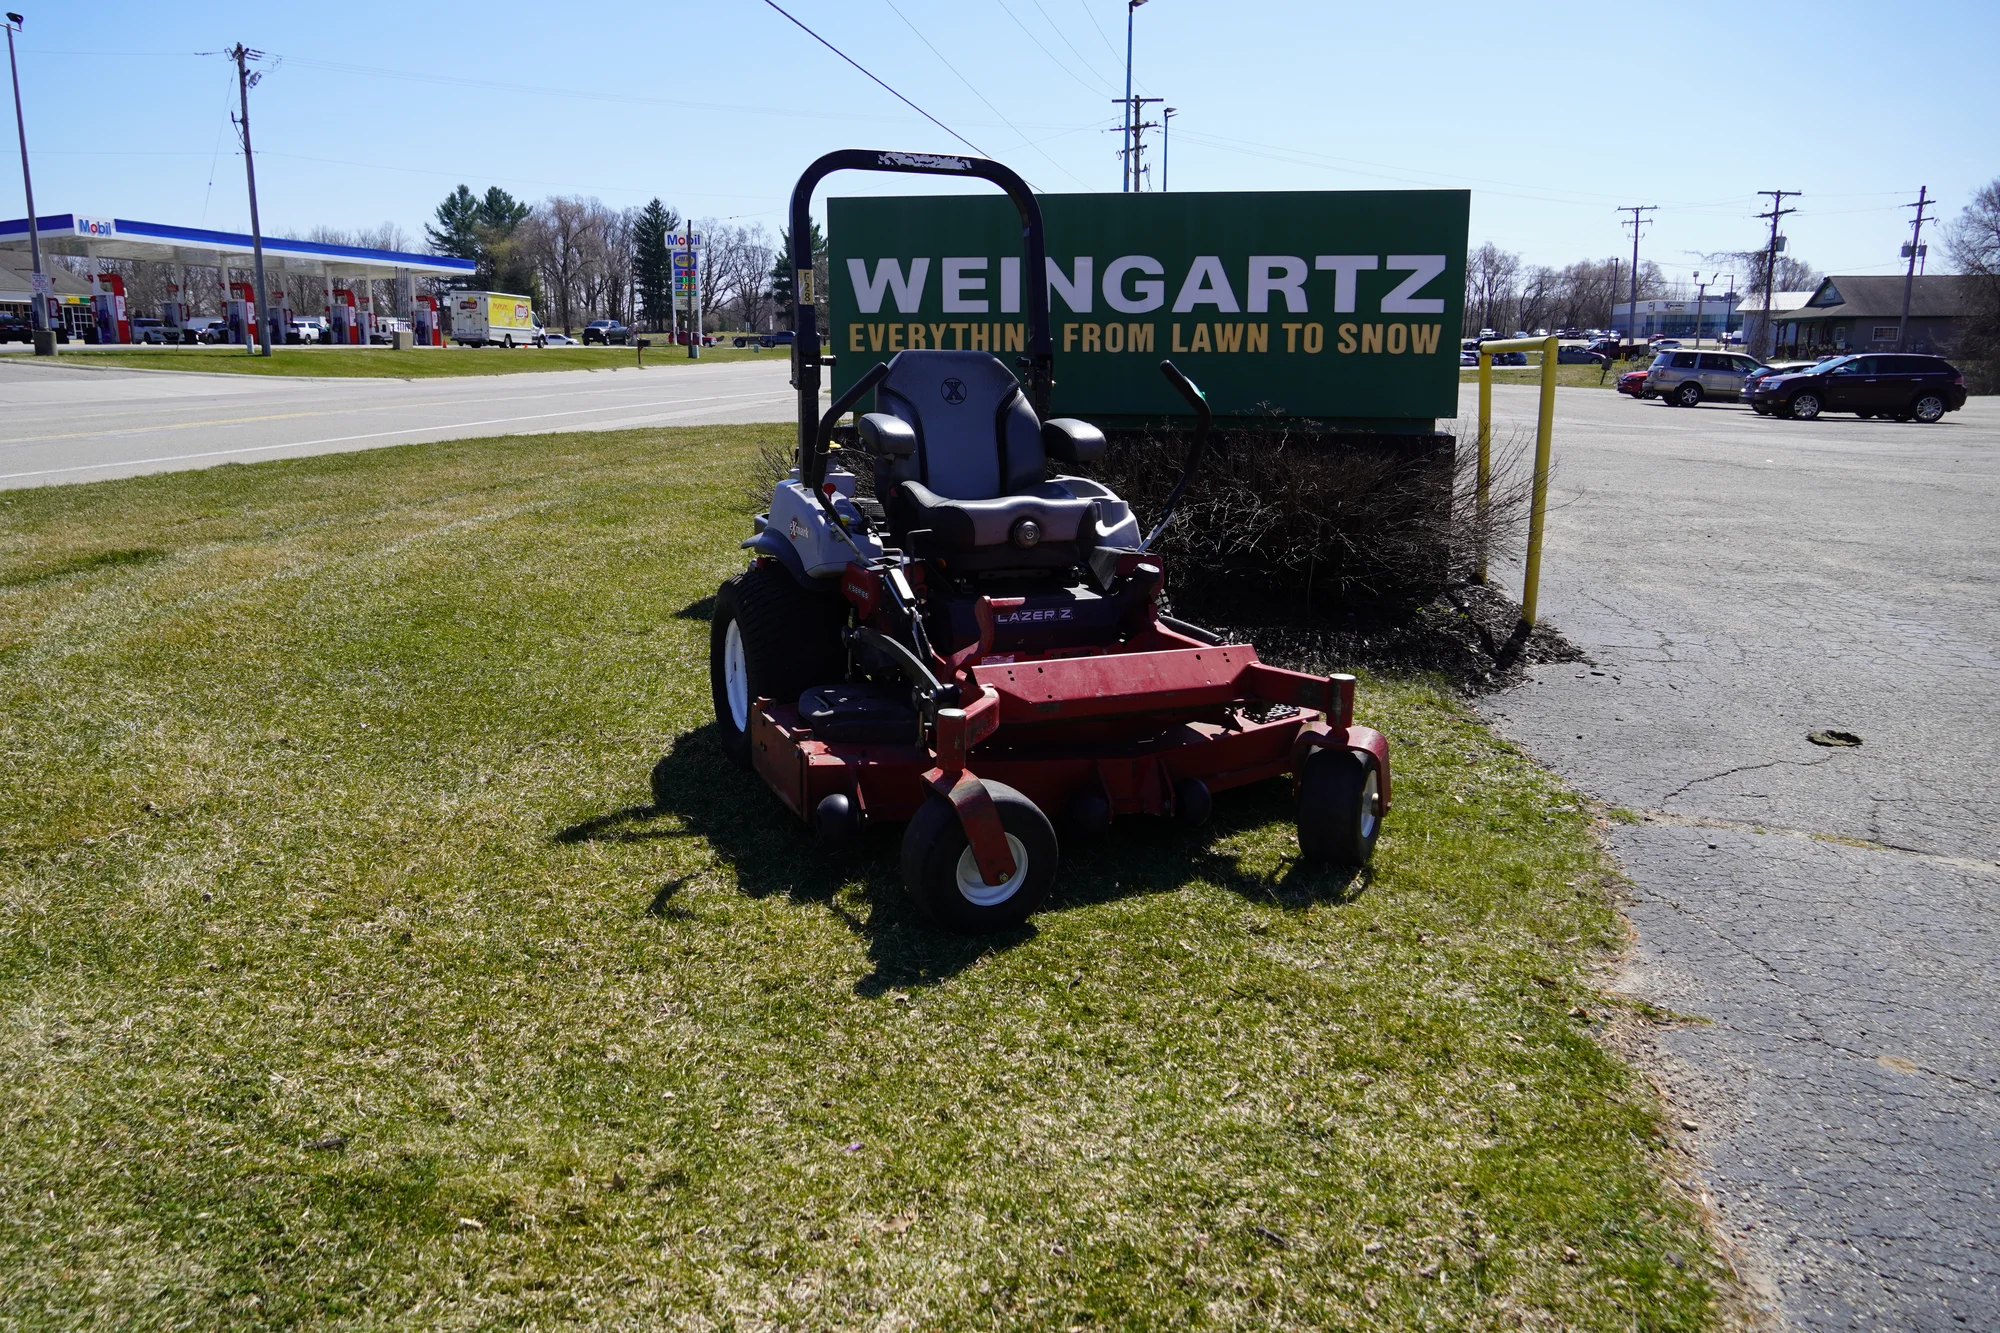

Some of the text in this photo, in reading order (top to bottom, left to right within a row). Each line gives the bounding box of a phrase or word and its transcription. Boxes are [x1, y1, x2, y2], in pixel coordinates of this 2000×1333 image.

[79, 219, 112, 236] Mobil
[667, 234, 701, 247] Mobil
[846, 255, 1447, 314] WEINGARTZ
[849, 322, 1442, 354] EVERYTHIN FROM LAWN TO SNOW
[997, 609, 1072, 623] LAZER Z
